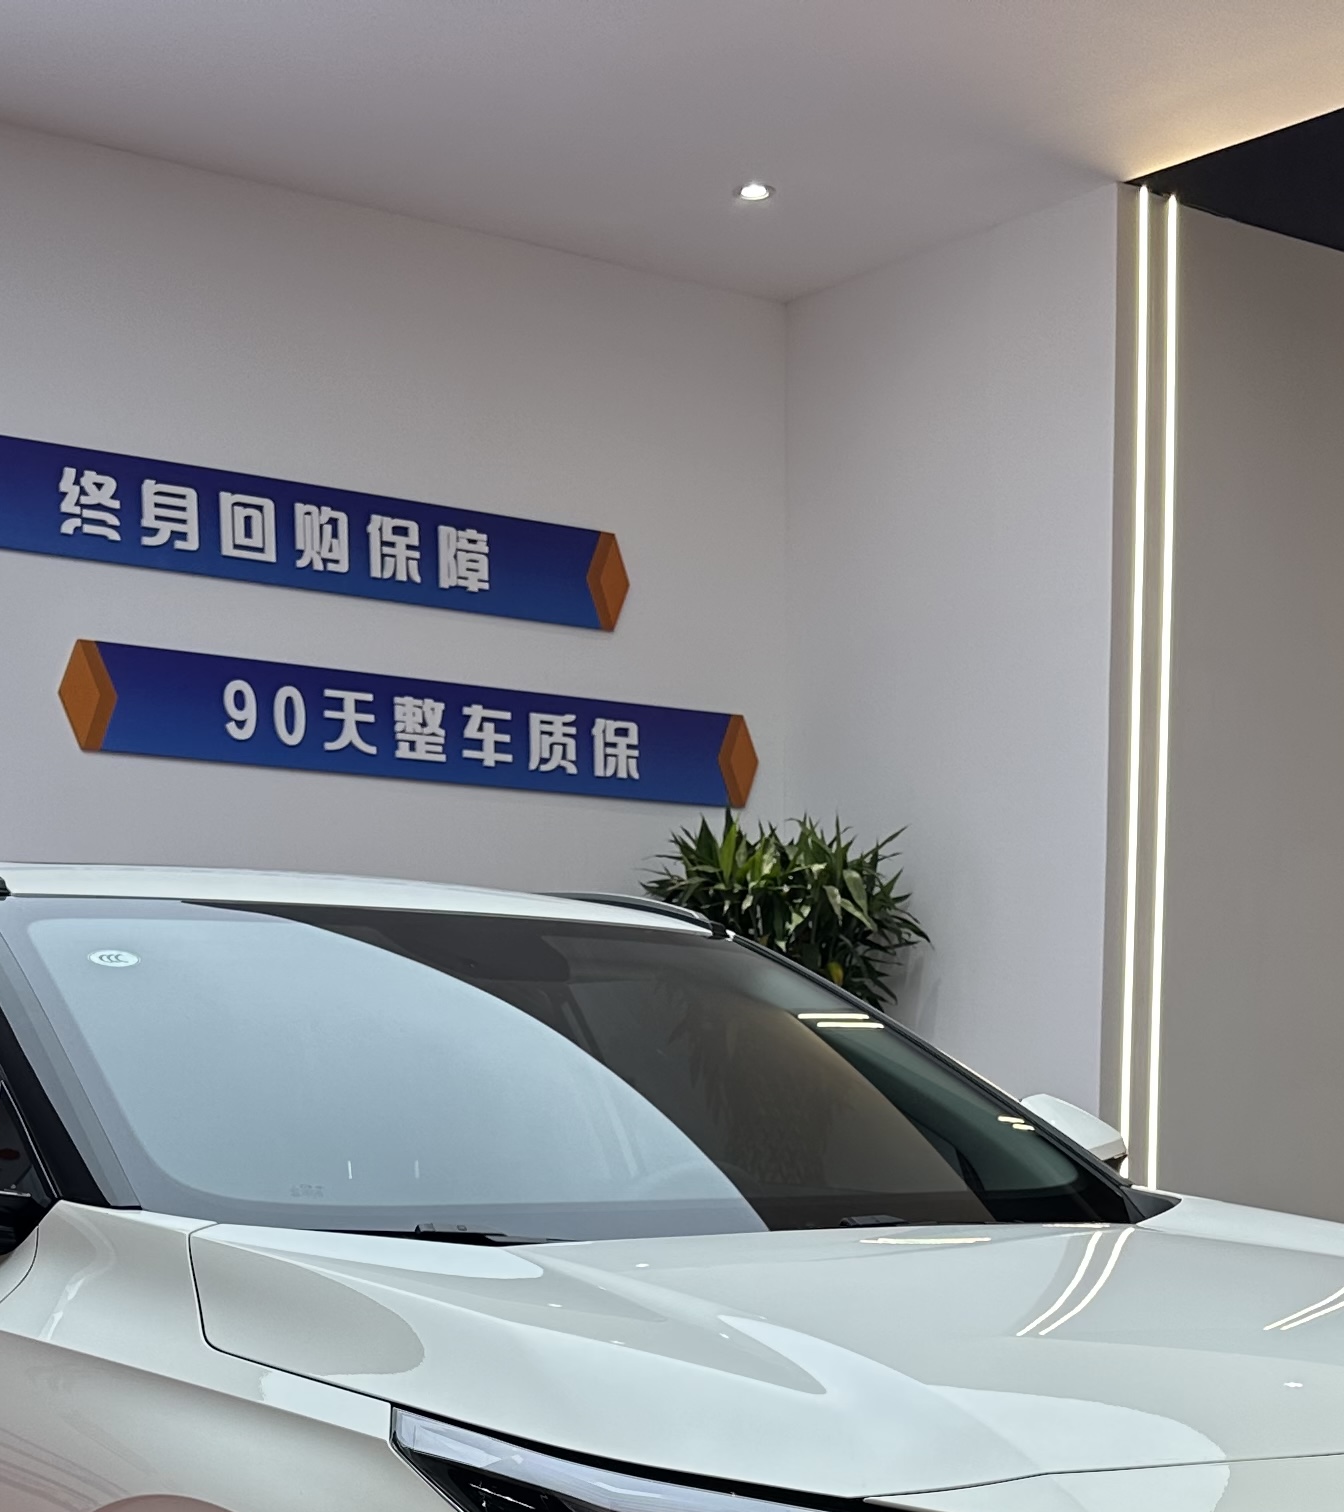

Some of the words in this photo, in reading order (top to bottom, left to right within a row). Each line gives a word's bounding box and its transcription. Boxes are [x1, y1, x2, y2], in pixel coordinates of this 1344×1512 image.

[59, 466, 492, 594] 终身回购保障
[223, 679, 641, 780] 90天整车质保
